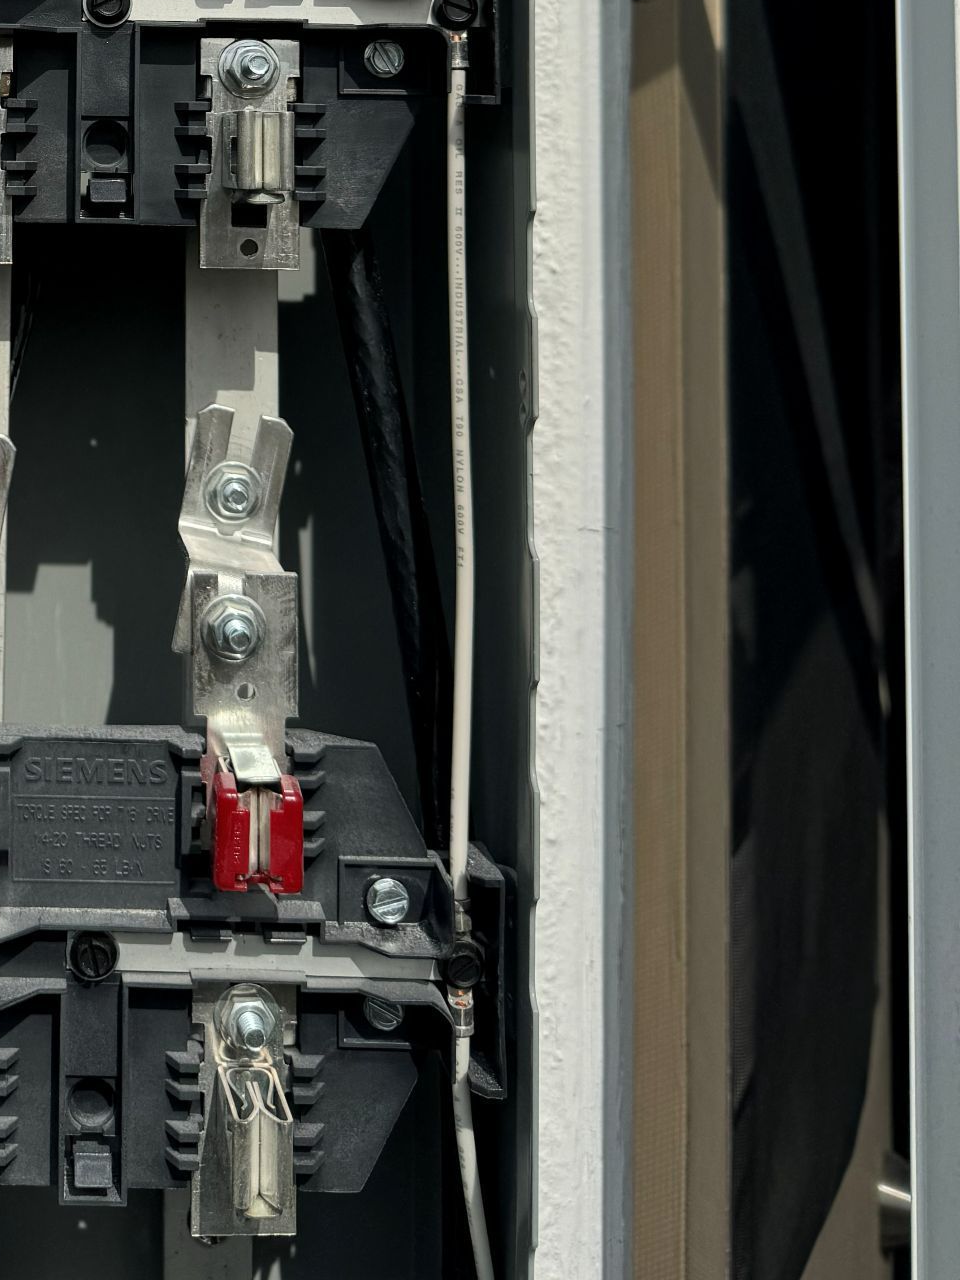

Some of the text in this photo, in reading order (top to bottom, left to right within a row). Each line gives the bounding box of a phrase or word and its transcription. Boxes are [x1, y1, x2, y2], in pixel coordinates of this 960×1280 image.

[455, 138, 464, 159] OIL
[455, 170, 464, 195] RES
[456, 416, 464, 438] T90
[456, 448, 465, 493] NYLON
[456, 504, 465, 535] 600V
[456, 546, 465, 568] FT1
[25, 756, 168, 785] SIEMENS
[61, 804, 86, 820] SPEC
[131, 833, 162, 850] NUTS
